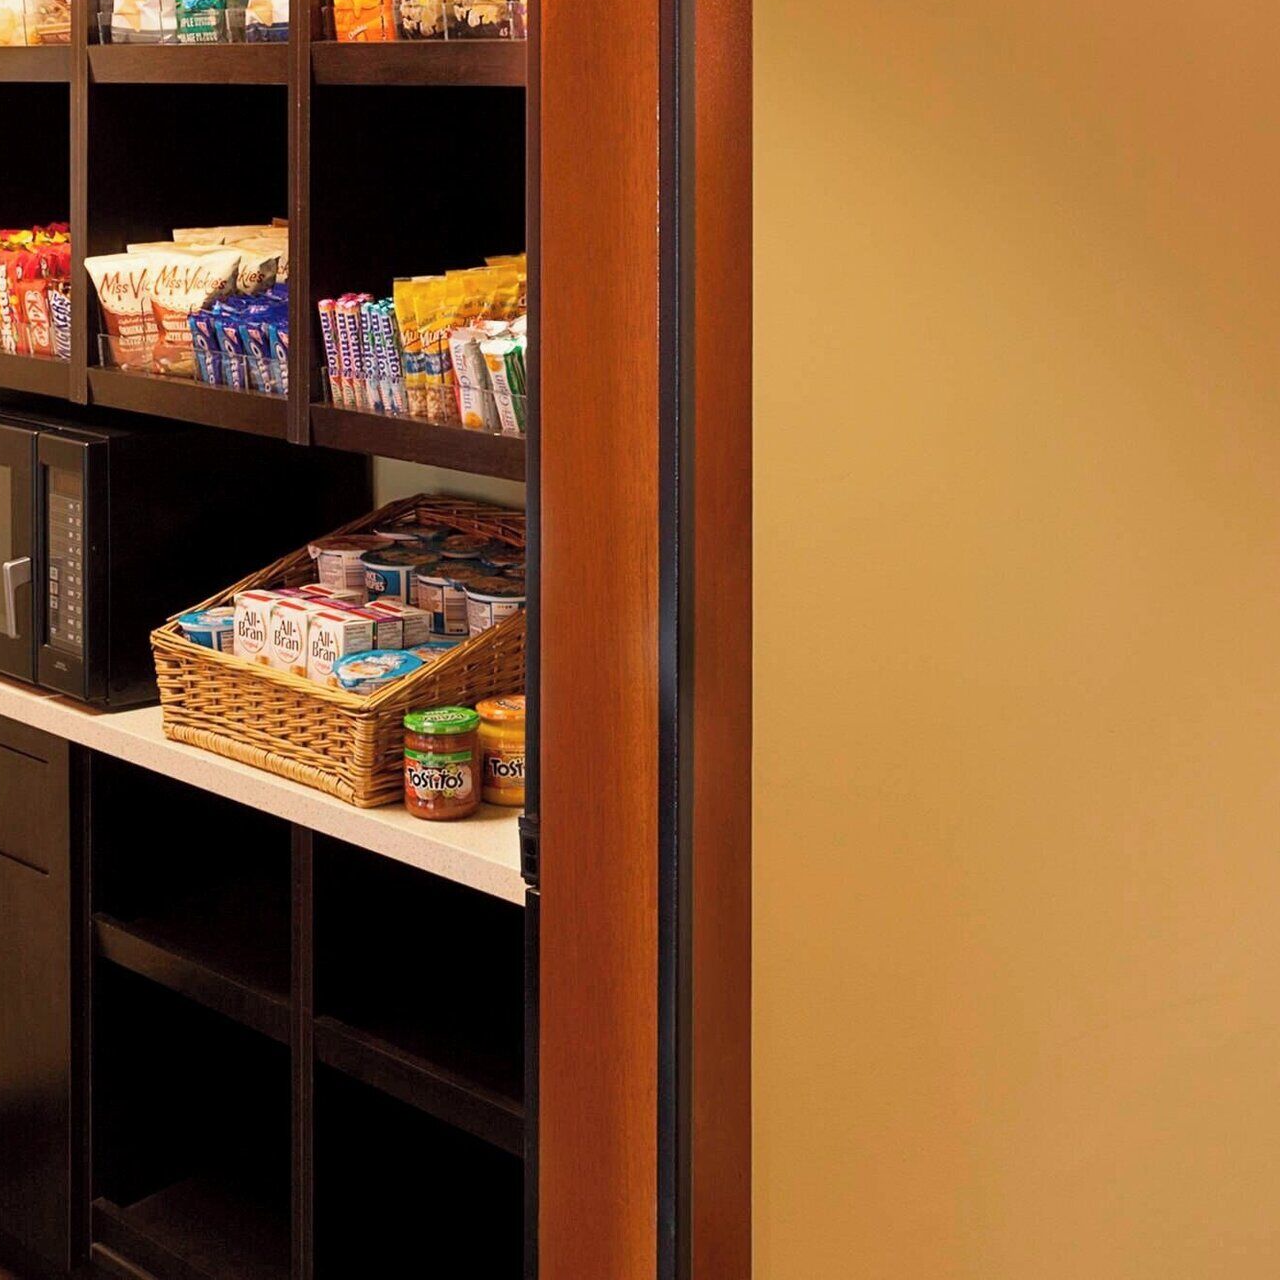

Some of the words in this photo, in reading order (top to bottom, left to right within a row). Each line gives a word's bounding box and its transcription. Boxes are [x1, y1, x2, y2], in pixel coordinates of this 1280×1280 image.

[100, 271, 129, 302] Miss
[154, 265, 182, 296] Miss
[184, 265, 228, 296] Vickie's
[321, 312, 338, 377] mentos
[338, 312, 352, 379] mentos
[347, 314, 362, 380] mentos
[361, 312, 374, 380] mentos
[371, 314, 387, 381] mentos
[382, 317, 401, 384] mentos
[238, 620, 264, 642] Bran
[243, 610, 261, 627] All-
[280, 619, 296, 637] All-
[274, 629, 299, 652] Bran
[312, 640, 336, 662] Bran
[317, 630, 334, 648] All-
[490, 757, 525, 778] Tost
